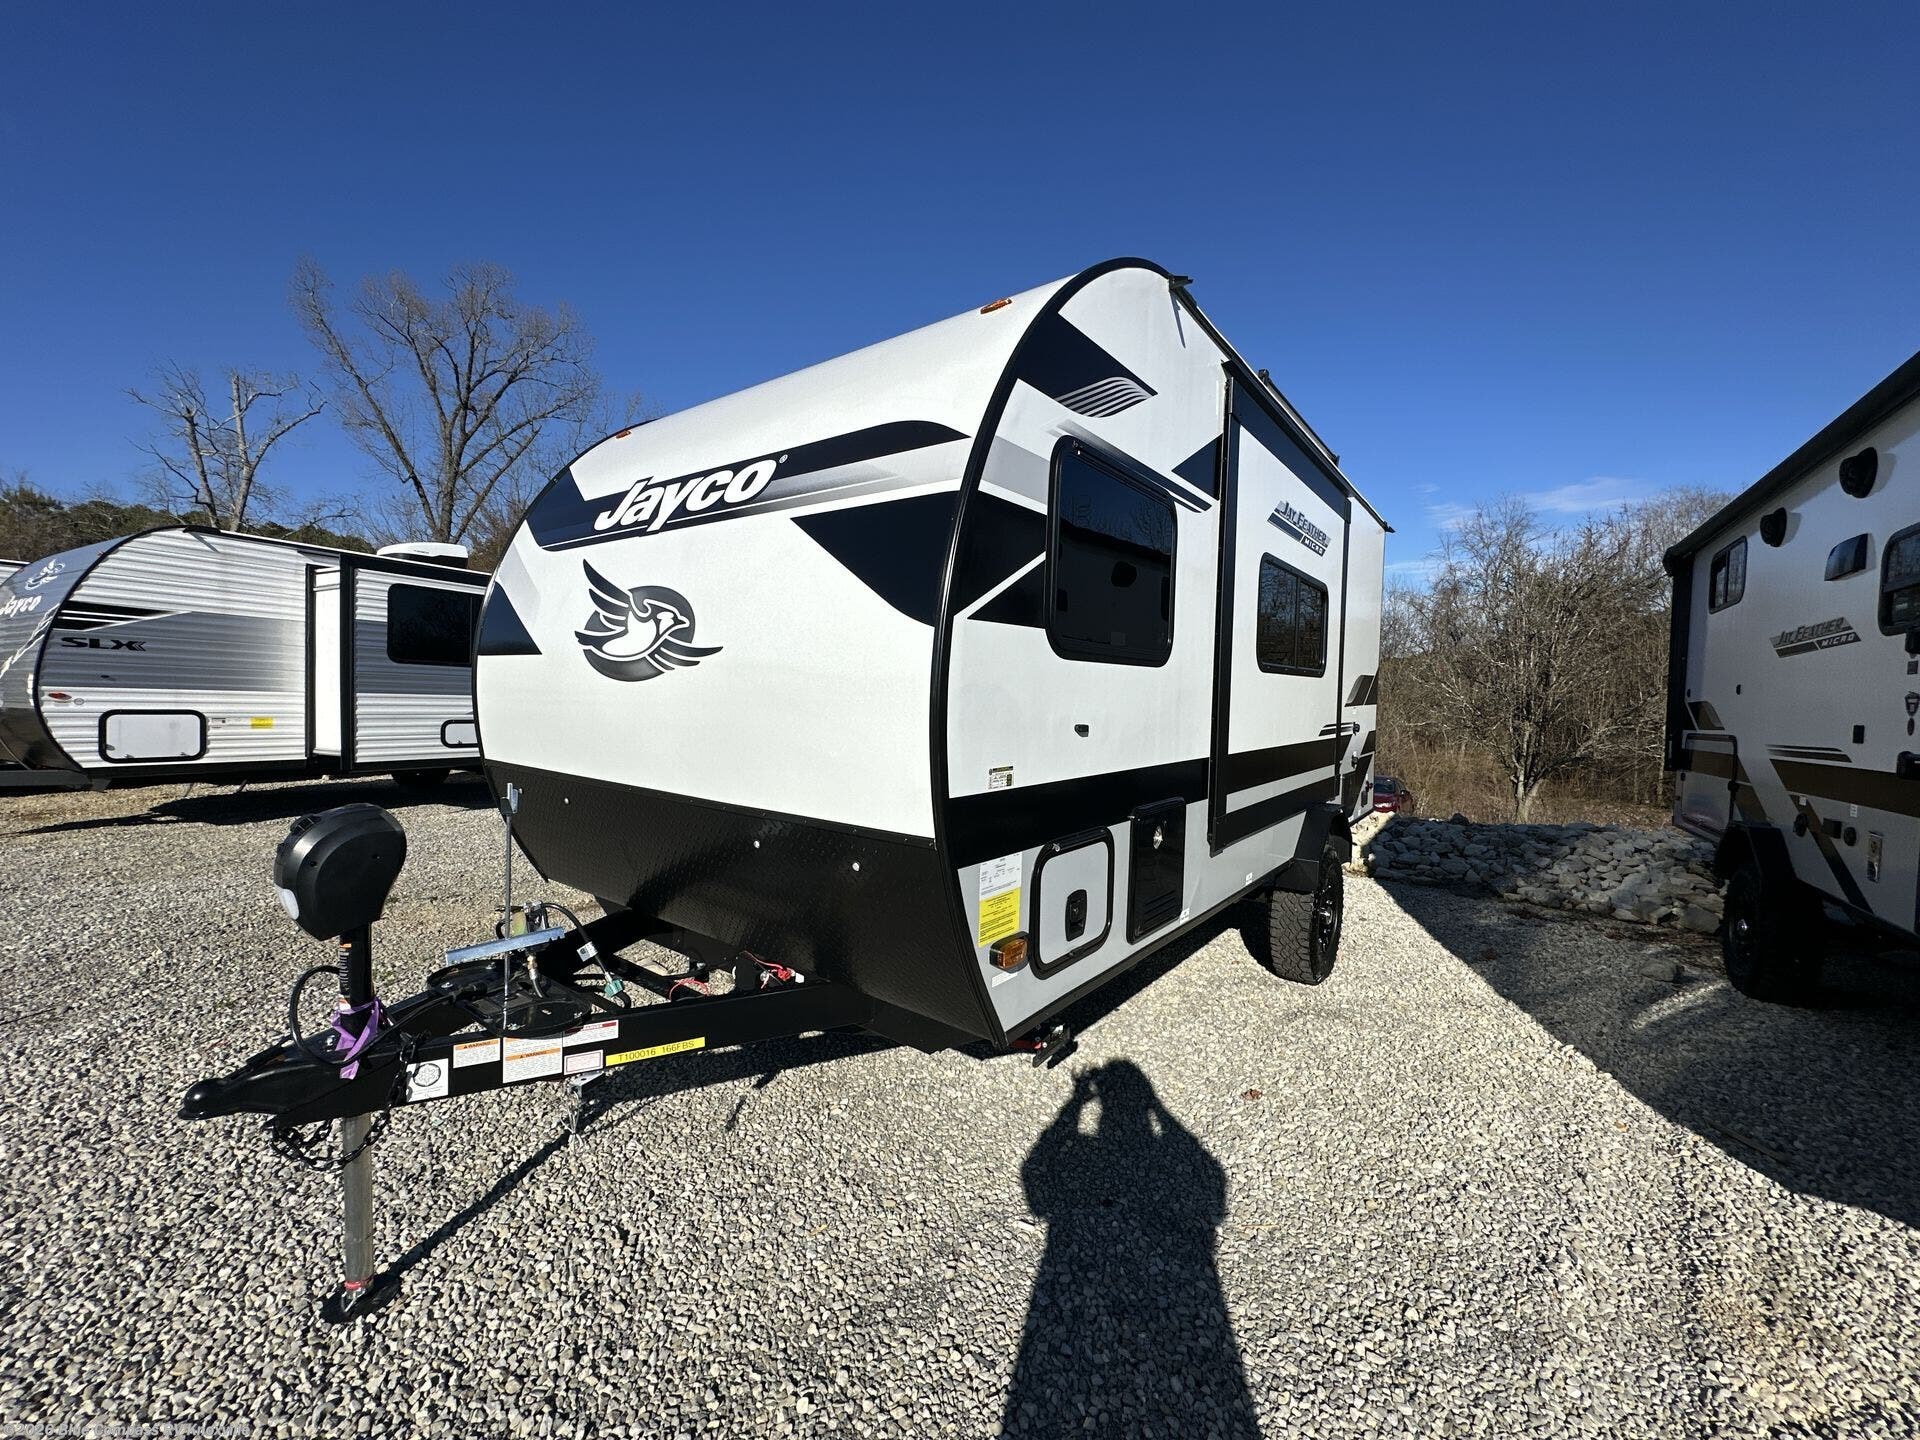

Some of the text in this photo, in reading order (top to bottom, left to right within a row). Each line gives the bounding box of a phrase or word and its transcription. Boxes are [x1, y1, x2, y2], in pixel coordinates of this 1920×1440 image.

[593, 459, 777, 532] Jayco
[1821, 632, 1856, 647] MICRO
[618, 1040, 695, 1062] T100016 166FBS
